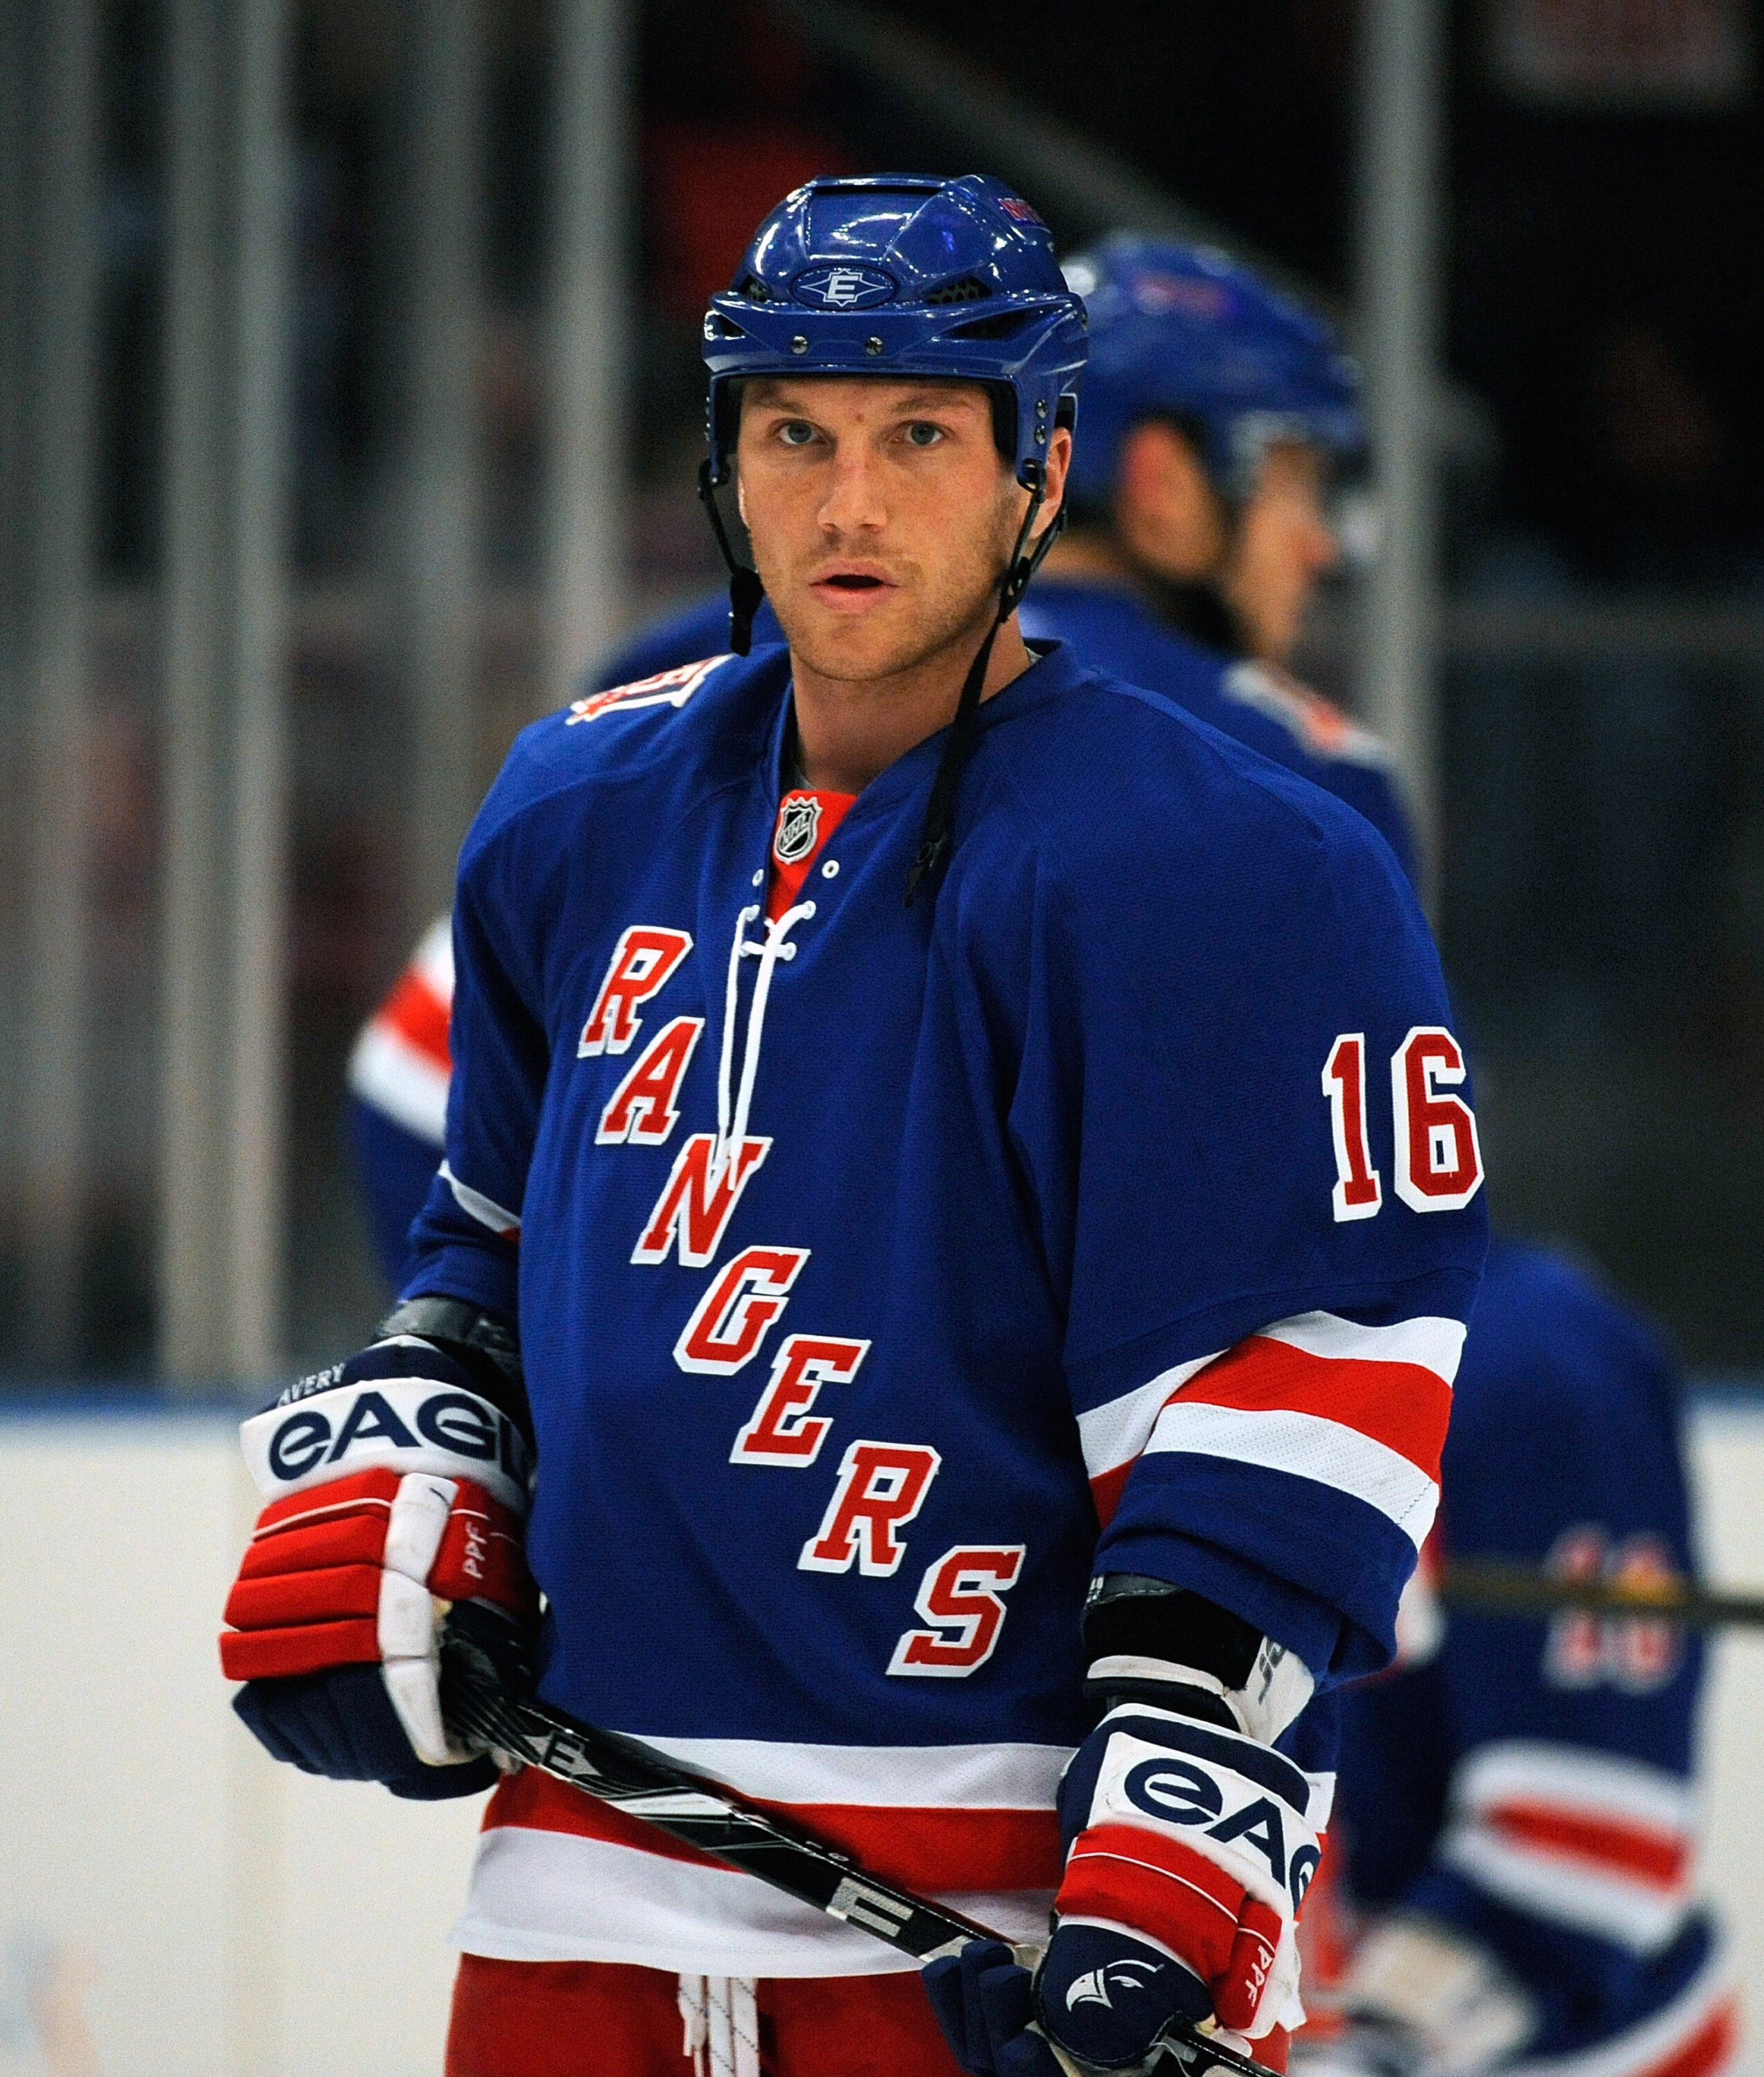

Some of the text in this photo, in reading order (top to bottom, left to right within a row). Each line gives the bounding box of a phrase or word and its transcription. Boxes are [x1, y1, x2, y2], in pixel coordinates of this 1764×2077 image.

[827, 275, 859, 299] E
[780, 813, 809, 849] NHL
[1322, 1026, 1485, 1223] 16
[577, 925, 1026, 1678] RANGERS
[277, 1362, 345, 1408] AVERY
[462, 1521, 487, 1579] PPF
[1245, 1944, 1273, 2008] PPF
